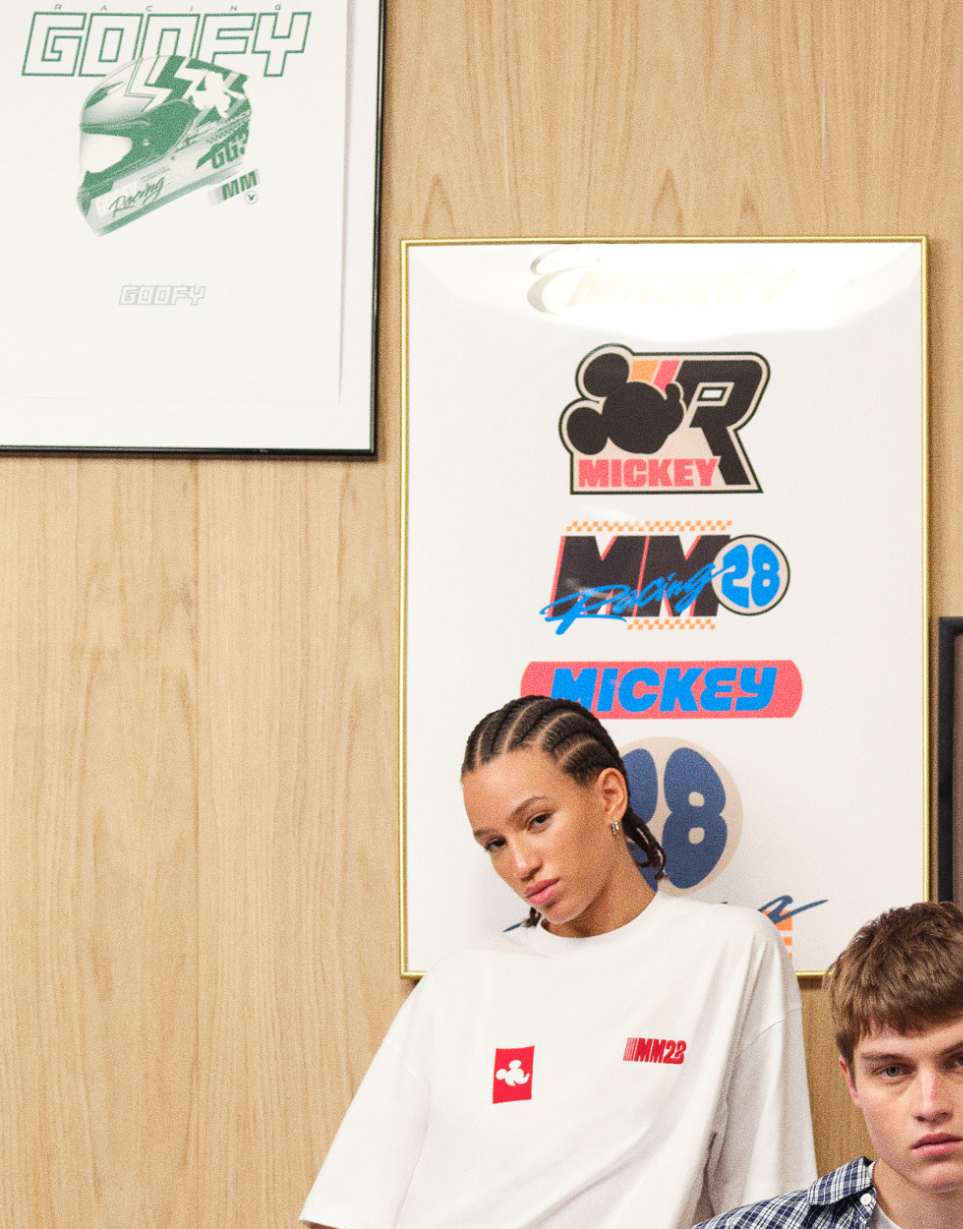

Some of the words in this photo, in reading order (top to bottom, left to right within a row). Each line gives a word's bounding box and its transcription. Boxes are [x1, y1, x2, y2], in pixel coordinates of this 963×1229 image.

[21, 12, 311, 77] GOOFY
[119, 285, 206, 306] GOOFY
[578, 458, 719, 488] MICKEY
[539, 562, 737, 636] Racing
[550, 534, 731, 618] MM
[721, 543, 780, 609] 28
[551, 667, 777, 713] MICKEY
